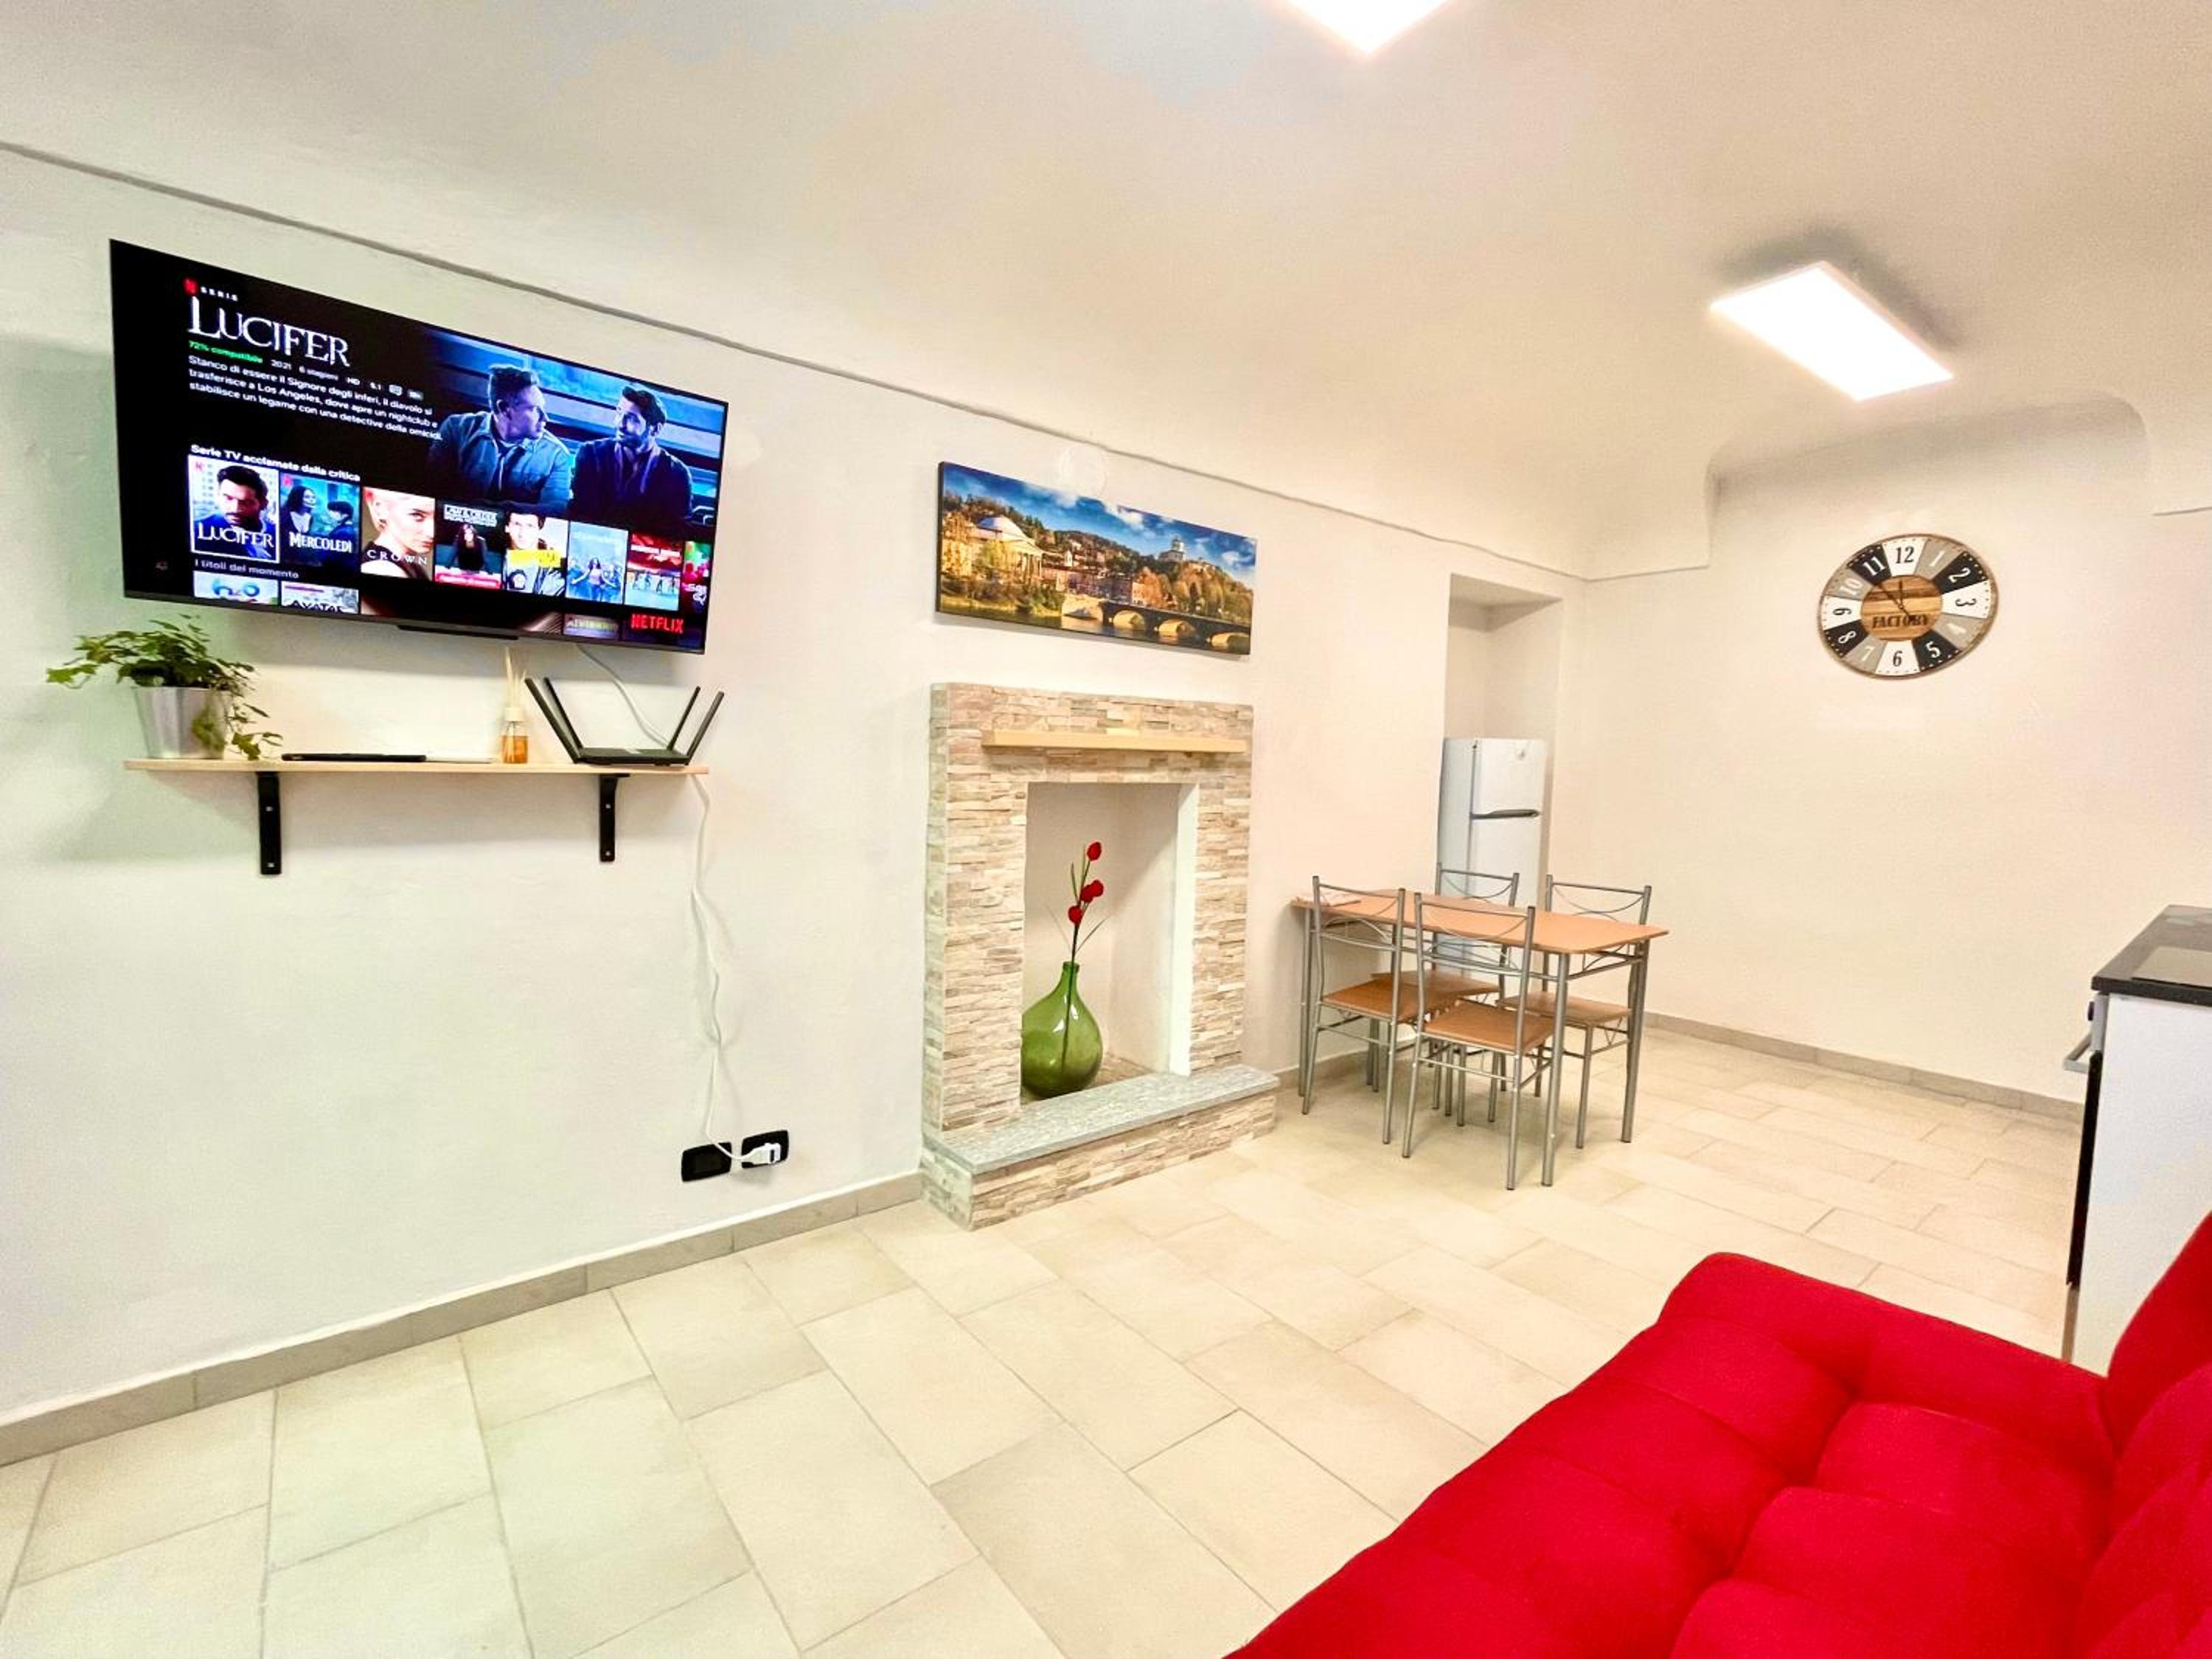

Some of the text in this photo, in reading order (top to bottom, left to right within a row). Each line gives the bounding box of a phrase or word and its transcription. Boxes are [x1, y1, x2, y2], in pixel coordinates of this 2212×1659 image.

[187, 295, 351, 367] LUCIFER
[271, 359, 293, 370] 2021
[347, 377, 361, 386] HD
[189, 355, 433, 416] Stanco di essere il Signore degli inferi, il diavolo si
[189, 369, 247, 388] trasferisce
[248, 382, 256, 390] a
[258, 383, 277, 394] Los
[279, 387, 323, 406] Angeles,
[324, 397, 349, 410] dove
[351, 404, 373, 416] apre
[375, 408, 387, 418] un
[389, 410, 431, 428] nightclub
[189, 382, 241, 399] stabilisce
[243, 393, 257, 402] un
[259, 394, 297, 411] legame
[299, 405, 318, 416] con
[319, 407, 338, 419] una
[339, 412, 383, 429] detective
[385, 422, 407, 434] della
[191, 444, 361, 481] Serie TV acclamate dalla critica
[198, 522, 274, 548] LUCIFER
[366, 549, 428, 566] CROWN
[1895, 546, 1915, 564] 12
[201, 560, 227, 570] titoli
[230, 563, 246, 572] del
[248, 567, 299, 579] momento
[1863, 556, 1886, 577] 11
[1948, 567, 1972, 583] 2
[1840, 577, 1863, 596] 10
[1832, 607, 1852, 616] 9
[1955, 598, 1978, 607] 3
[630, 613, 684, 634] NETFLIX
[1872, 614, 1929, 628] FACTORY
[1838, 630, 1857, 644] 8
[1893, 650, 1903, 667] 6
[1925, 641, 1941, 658] 5
